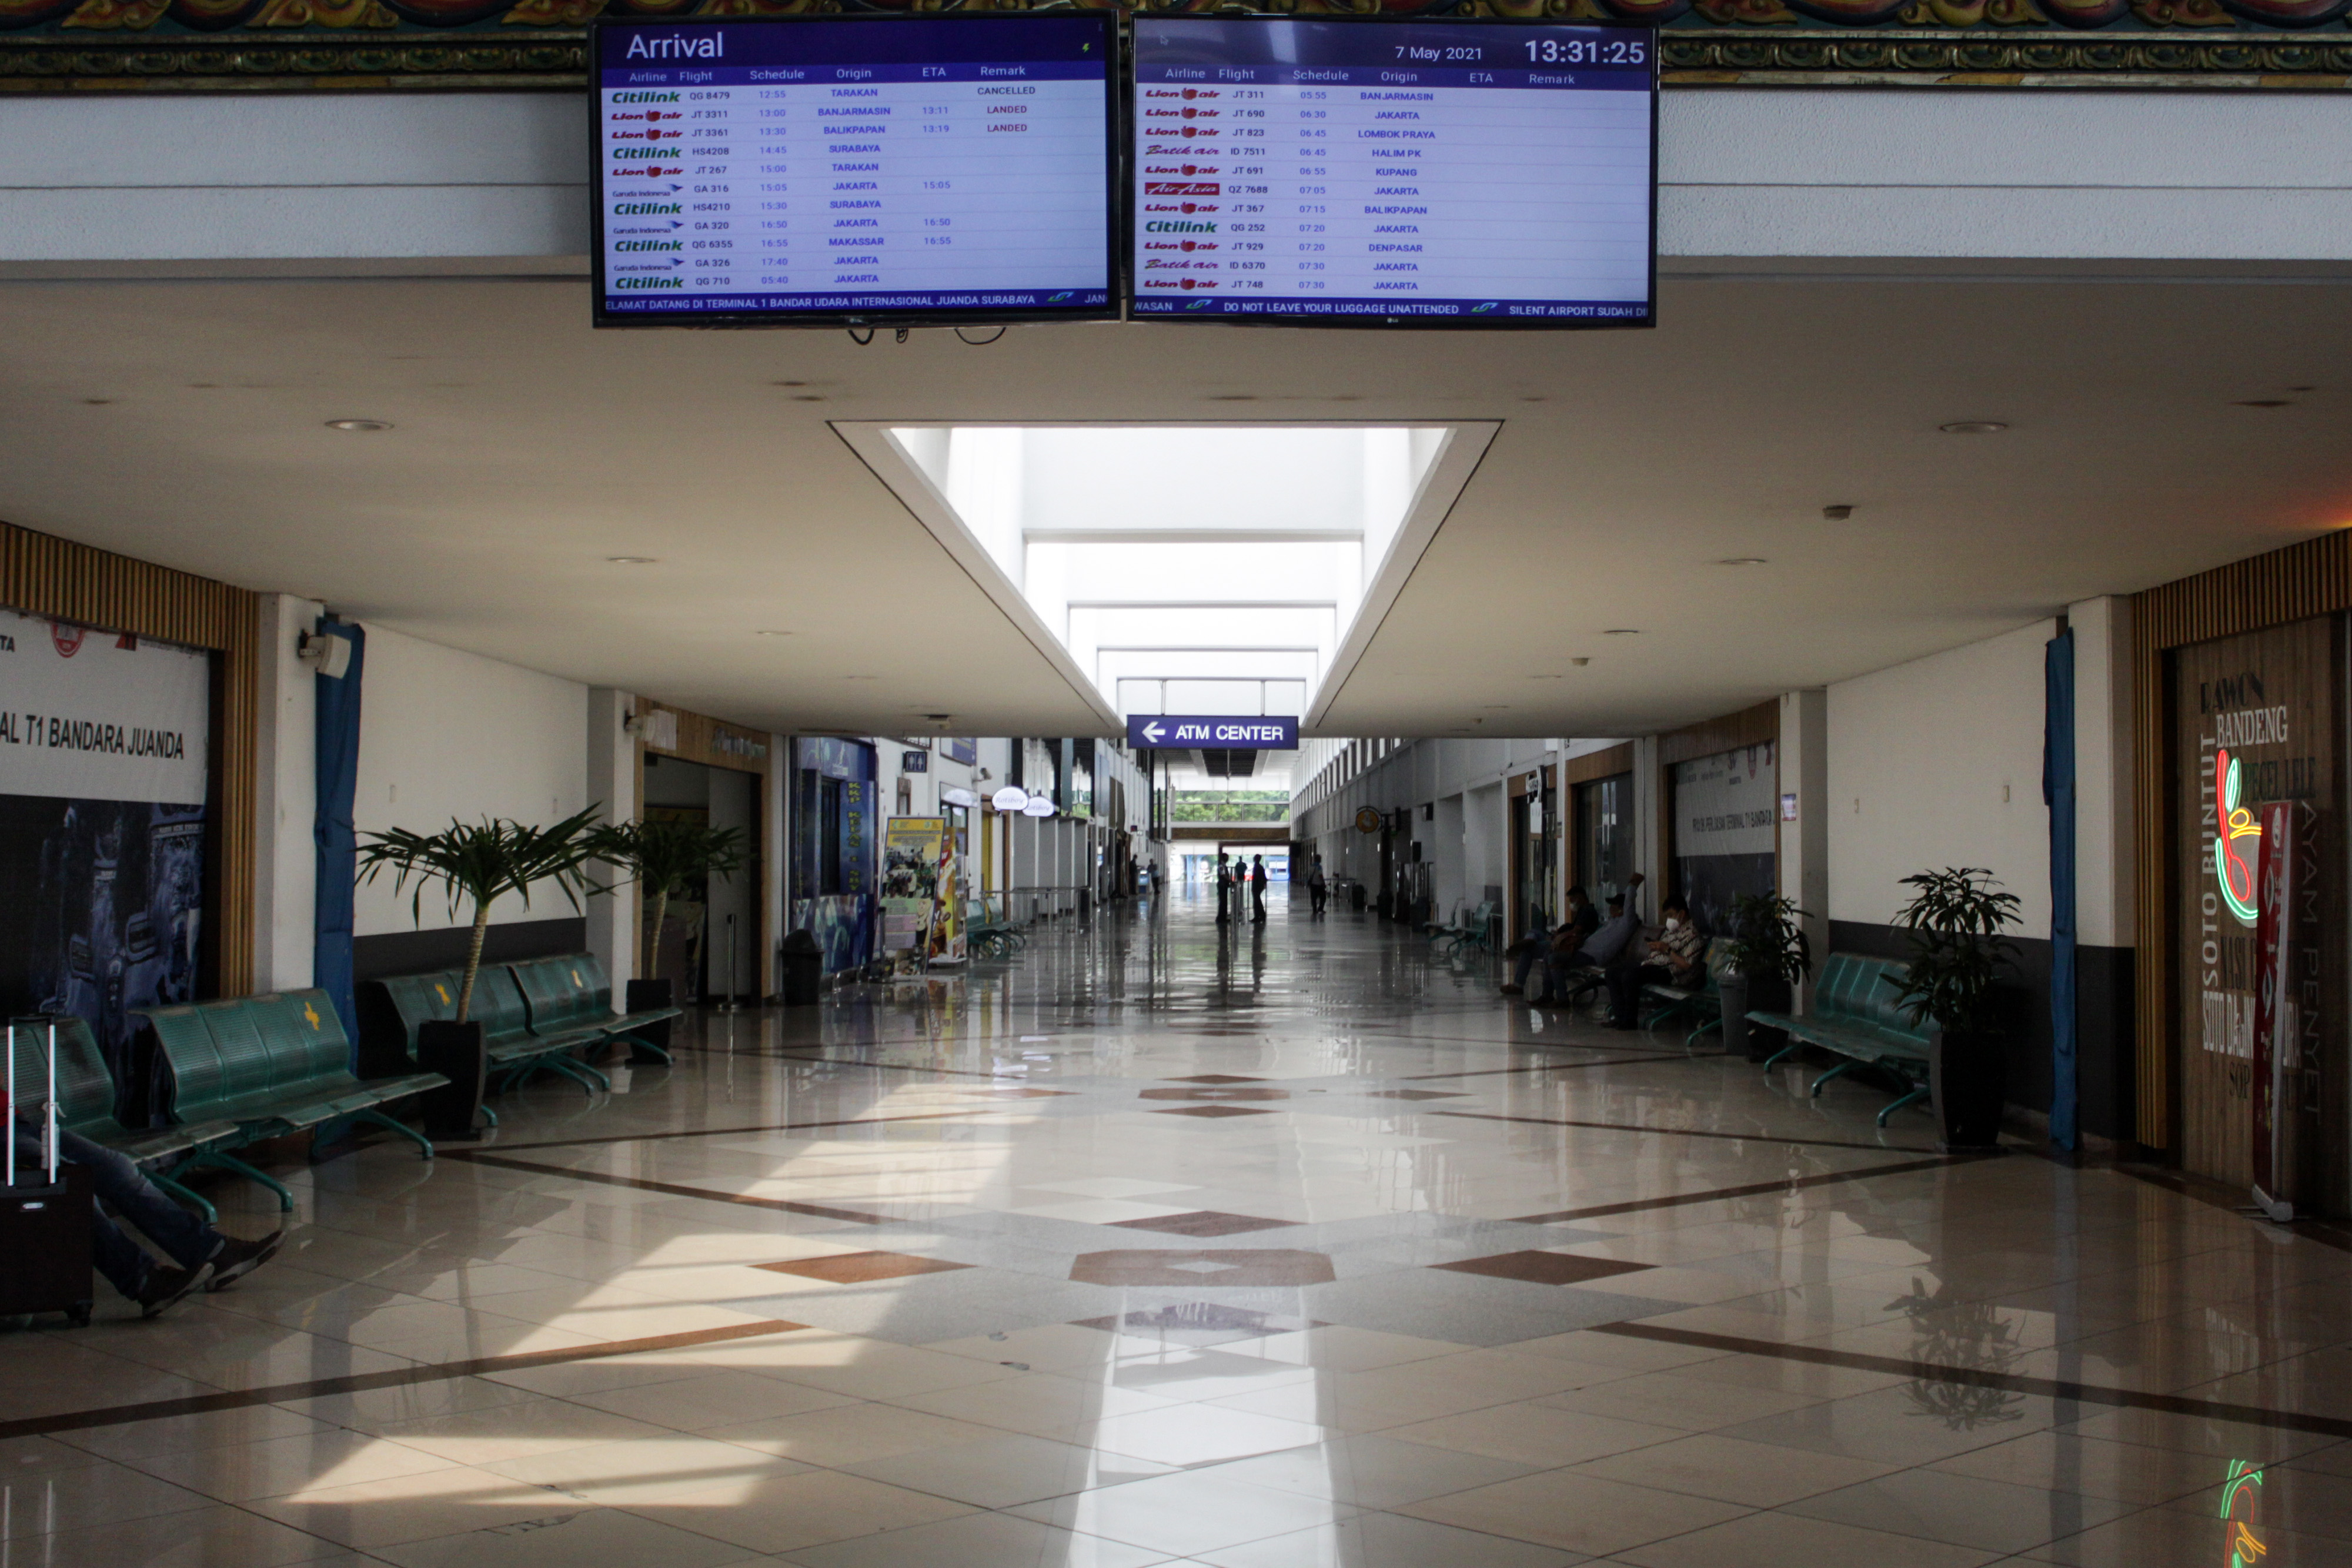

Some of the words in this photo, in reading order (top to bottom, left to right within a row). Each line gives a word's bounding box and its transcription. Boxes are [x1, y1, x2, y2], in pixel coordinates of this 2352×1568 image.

[626, 31, 723, 59] Arrival
[1525, 40, 1644, 63] 13:31:25
[1395, 46, 1405, 58] 7
[1410, 46, 1441, 62] May
[1446, 47, 1481, 60] 2021
[629, 72, 667, 82] Airline
[679, 71, 712, 83] Flight
[750, 69, 804, 79] Schedule
[836, 68, 871, 81] Origin
[922, 67, 946, 77] ETA
[980, 66, 1025, 76] Remark
[1165, 68, 1205, 78] Airline
[1219, 69, 1254, 82] Flight
[1292, 69, 1349, 81] Schedule
[1381, 71, 1417, 83] Origin
[1469, 72, 1494, 83] ETA
[1529, 73, 1575, 84] Remark
[612, 91, 680, 104] Citilink
[689, 92, 704, 101] QG
[706, 91, 730, 100] 8479
[759, 89, 787, 99] 12:55
[831, 88, 878, 97] TARAKAN
[977, 86, 1036, 95] CANCELLED
[1232, 90, 1245, 99] JT
[1247, 91, 1264, 99] 311
[1360, 92, 1434, 101] BANJARMASIN
[691, 110, 703, 119] JT
[705, 110, 728, 119] 3311
[759, 108, 786, 118] 13:00
[817, 107, 891, 116] BANJARMASIN
[922, 106, 948, 115] 13:11
[987, 105, 1027, 115] LANDED
[1232, 109, 1245, 118] JT
[1247, 109, 1265, 118] 690
[1375, 111, 1420, 120] JAKARTA
[691, 128, 703, 138] JT
[705, 128, 728, 137] 3361
[759, 127, 787, 136] 13:30
[823, 125, 886, 135] BALIKPAPAN
[923, 124, 950, 133] 13:19
[987, 123, 1028, 133] LANDED
[1232, 128, 1245, 136] JT
[1247, 128, 1265, 137] 823
[1358, 129, 1401, 138] LOMBOK
[1402, 130, 1436, 139] PRAYA
[613, 147, 681, 159] Citilink
[692, 147, 730, 156] HS4208
[760, 146, 787, 155] 14:45
[828, 144, 881, 153] SURABAYA
[1230, 147, 1240, 156] ID
[1244, 147, 1265, 156] 7511
[1372, 149, 1405, 158] HALIM
[1407, 149, 1421, 158] PK
[694, 166, 707, 175] JT
[709, 165, 727, 175] 267
[760, 164, 787, 173] 15:00
[831, 163, 879, 172] TARAKAN
[1232, 166, 1244, 175] JT
[1246, 166, 1264, 175] 691
[1375, 168, 1418, 177] KUPANG
[693, 185, 709, 193] GA
[711, 185, 729, 193] 316
[760, 183, 788, 192] 15:05
[833, 181, 878, 190] JAKARTA
[923, 180, 951, 189] 15:05
[1228, 185, 1242, 194] QZ
[1245, 185, 1268, 194] 7688
[1374, 187, 1419, 196] JAKARTA
[614, 203, 682, 215] Citilink
[693, 203, 731, 212] HS4210
[761, 202, 788, 210] 15:30
[829, 200, 881, 209] SURABAYA
[1231, 204, 1244, 213] JT
[1246, 204, 1265, 213] 367
[1364, 205, 1428, 215] BALIKPAPAN
[694, 222, 709, 230] GA
[711, 221, 730, 230] 320
[761, 220, 788, 229] 16:50
[833, 218, 878, 228] JAKARTA
[924, 218, 951, 226] 16:50
[1145, 220, 1217, 233] Citilink
[1230, 223, 1245, 232] QG
[1247, 223, 1265, 232] 252
[1374, 225, 1419, 233] JAKARTA
[614, 240, 683, 252] Citilink
[691, 240, 706, 250] QG
[709, 240, 733, 249] 6355
[761, 239, 789, 248] 16:55
[828, 237, 884, 246] MAKASSAR
[924, 236, 952, 245] 16:55
[1231, 242, 1244, 250] JT
[1245, 242, 1264, 251] 929
[1368, 243, 1423, 252] DENPASAR
[695, 259, 710, 268] GA
[711, 259, 730, 268] 326
[762, 258, 789, 266] 17:40
[834, 256, 879, 265] JAKARTA
[1229, 261, 1240, 270] ID
[1241, 262, 1266, 270] 6370
[1373, 263, 1419, 271] JAKARTA
[615, 277, 683, 289] Citilink
[695, 277, 710, 286] QG
[713, 276, 730, 285] 710
[761, 276, 789, 285] 05:40
[834, 274, 880, 283] JAKARTA
[1231, 280, 1244, 289] JT
[1247, 280, 1264, 289] 748
[1373, 282, 1418, 290] JAKARTA
[649, 300, 690, 309] DATANG
[693, 299, 703, 309] DI
[706, 299, 758, 308] TERMINAL
[761, 299, 766, 307] 1
[770, 297, 812, 307] BANDAR
[814, 297, 849, 307] UDARA
[852, 296, 933, 306] INTERNASIONAL
[937, 296, 978, 305] JUANDA
[981, 295, 1035, 305] SURABAYA
[1224, 302, 1239, 312] DO
[1242, 302, 1264, 312] NOT
[1267, 303, 1301, 312] LEAVE
[1303, 303, 1332, 313] YOUR
[1335, 304, 1385, 313] LUGGAGE
[1388, 305, 1459, 315] UNATTENDED
[1509, 306, 1545, 315] SILENT
[1548, 306, 1594, 316] AIRPORT
[1598, 307, 1632, 316] SUDAH
[1175, 724, 1210, 740] ATM
[1215, 724, 1284, 741] CENTER
[2216, 706, 2288, 748] BANDENG
[25, 714, 44, 746] T1
[48, 717, 125, 754] BANDARA
[127, 728, 184, 760] JUANDA
[2200, 733, 2217, 874] BUNTUT
[2301, 800, 2317, 923] AYAM
[2201, 892, 2219, 987] SOTO
[2303, 947, 2321, 1125] PENYET
